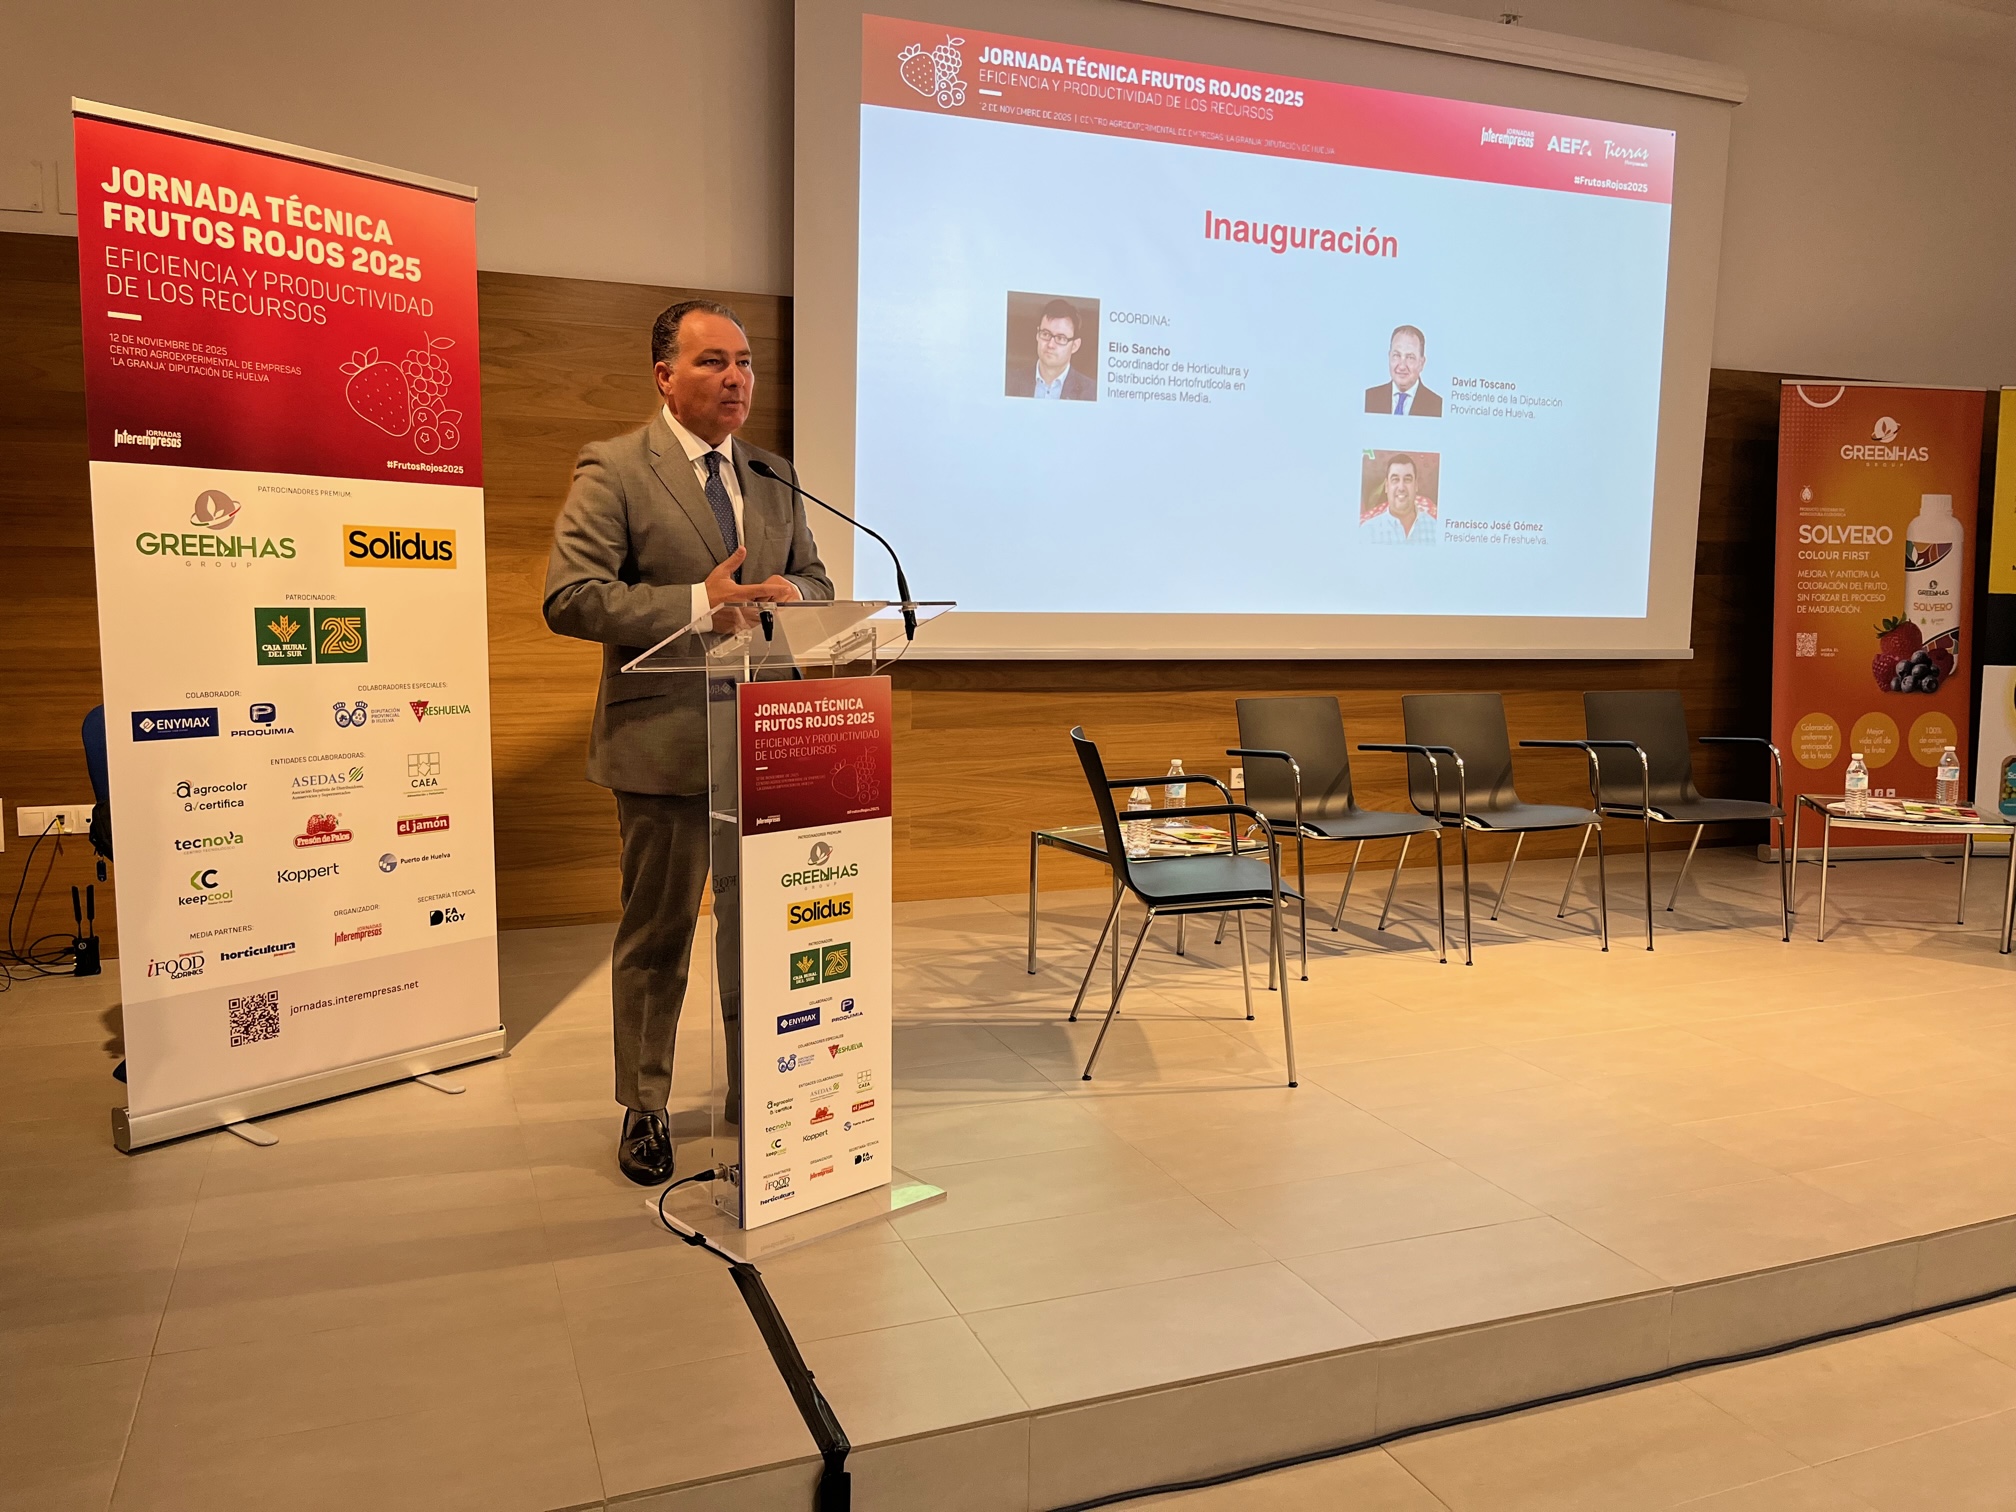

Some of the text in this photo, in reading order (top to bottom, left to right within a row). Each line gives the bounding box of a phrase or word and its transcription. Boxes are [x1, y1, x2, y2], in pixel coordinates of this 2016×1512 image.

[979, 46, 1304, 107] JORNADA TÉCNICA FRUTOS ROJOS 2025
[979, 69, 1274, 121] EFICIENCIA Y PRODUCTIVIDAD DE LOS RECURSOS
[1481, 127, 1534, 149] Interempresas
[1506, 128, 1534, 138] JORNADAS
[1604, 140, 1649, 160] Tierras
[1574, 176, 1648, 193] #FrutosRojos2025
[101, 166, 393, 245] JORNADA TÉCNICA
[103, 201, 421, 282] FRUTOS ROJOS 2025
[1204, 210, 1398, 258] Inauguración
[106, 246, 433, 317] EFICIENCIA Y PRODUCTIVIDAD
[107, 274, 327, 325] DE LOS RECURSOS
[1109, 311, 1170, 327] COORDINA:
[109, 333, 227, 356] 12 DE NOVIEMBRE DE 2025
[1108, 342, 1170, 356] Elio Sancho
[110, 345, 301, 375] CENTRO AGROEXPERIMENTAL DE EMPRESAS
[169, 363, 220, 377] DIPUTACIÓN
[222, 370, 233, 379] DE
[236, 372, 269, 382] HUELVA
[1108, 357, 1249, 379] Coordinador de Horticultura y
[1107, 372, 1246, 391] Distribución Hortofrutícola en
[1452, 377, 1516, 390] David Toscano
[1107, 387, 1211, 404] Interempresas Media.
[1451, 391, 1562, 407] Presidente de la Diputación
[1450, 404, 1535, 419] Provincial de Huelva.
[114, 429, 182, 450] Interempresas
[146, 430, 181, 438] JORNADAS
[1840, 445, 1929, 461] GREENHAS
[387, 460, 464, 474] #FrutosRojos2025
[258, 486, 319, 496] PATROCINADORES
[1445, 519, 1543, 531] Francisco José Gómez
[1444, 532, 1548, 545] Presidente de Freshuelva.
[1799, 525, 1893, 544] SOLVERO
[136, 532, 296, 559] GREENHAS
[349, 530, 453, 561] Solidus
[1798, 551, 1869, 560] COLOUR FIRST
[1798, 570, 1827, 578] MEJORA
[1830, 570, 1834, 578] Y
[1836, 570, 1869, 578] ANTICIPA
[1798, 580, 1889, 591] COLORACIÓN DEL FRUTO,
[1851, 594, 1886, 602] PROCESO
[1808, 604, 1861, 614] MADURACIÓN.
[1914, 603, 1952, 612] SOLVERO
[321, 617, 362, 654] 25
[358, 683, 411, 691] COLABORADORES
[186, 691, 242, 699] COLABORADOR:
[418, 705, 471, 718] FRESHUELVA
[754, 697, 863, 717] JORNADA TÉCNICA
[157, 717, 210, 730] ENYMAX
[755, 712, 875, 732] FRUTOS ROJOS 2025
[231, 728, 294, 737] PROQUIMIA
[755, 730, 879, 749] EFICIENCIA Y PRODUCTIVIDAD
[1867, 728, 1884, 736] Mejor
[271, 752, 365, 765] ENTIDADES COLABORADORAS:
[756, 745, 837, 761] DE LOS RECURSOS
[292, 773, 346, 787] ASEDAS
[411, 777, 438, 788] CAEA
[193, 782, 247, 796] agrocolor
[400, 817, 447, 832] el jamón
[175, 831, 244, 851] tecnova
[297, 836, 321, 846] Fresón
[331, 832, 350, 842] Palos
[400, 857, 420, 865] Puerto
[277, 863, 339, 883] Koppert
[781, 863, 858, 888] GREENHAS
[178, 890, 233, 906] keepcool
[418, 892, 451, 903] SECRETARÍA
[334, 904, 380, 917] ORGANIZADOR:
[445, 907, 458, 915] FA
[445, 913, 466, 923] KOY
[790, 899, 851, 924] Solidus
[190, 925, 254, 940] MEDIA PARTNERS:
[357, 923, 382, 931] JORNADAS
[334, 928, 382, 946] Interempresas
[220, 942, 295, 961] horticultura
[147, 955, 205, 978] iFOOD
[825, 948, 848, 976] 25
[290, 980, 419, 1016] jornadas.interempresas.net
[788, 1014, 816, 1026] ENYMAX
[832, 1012, 863, 1022] PROQUIMIA
[766, 1121, 792, 1133] tecnova
[803, 1130, 828, 1142] Koppert
